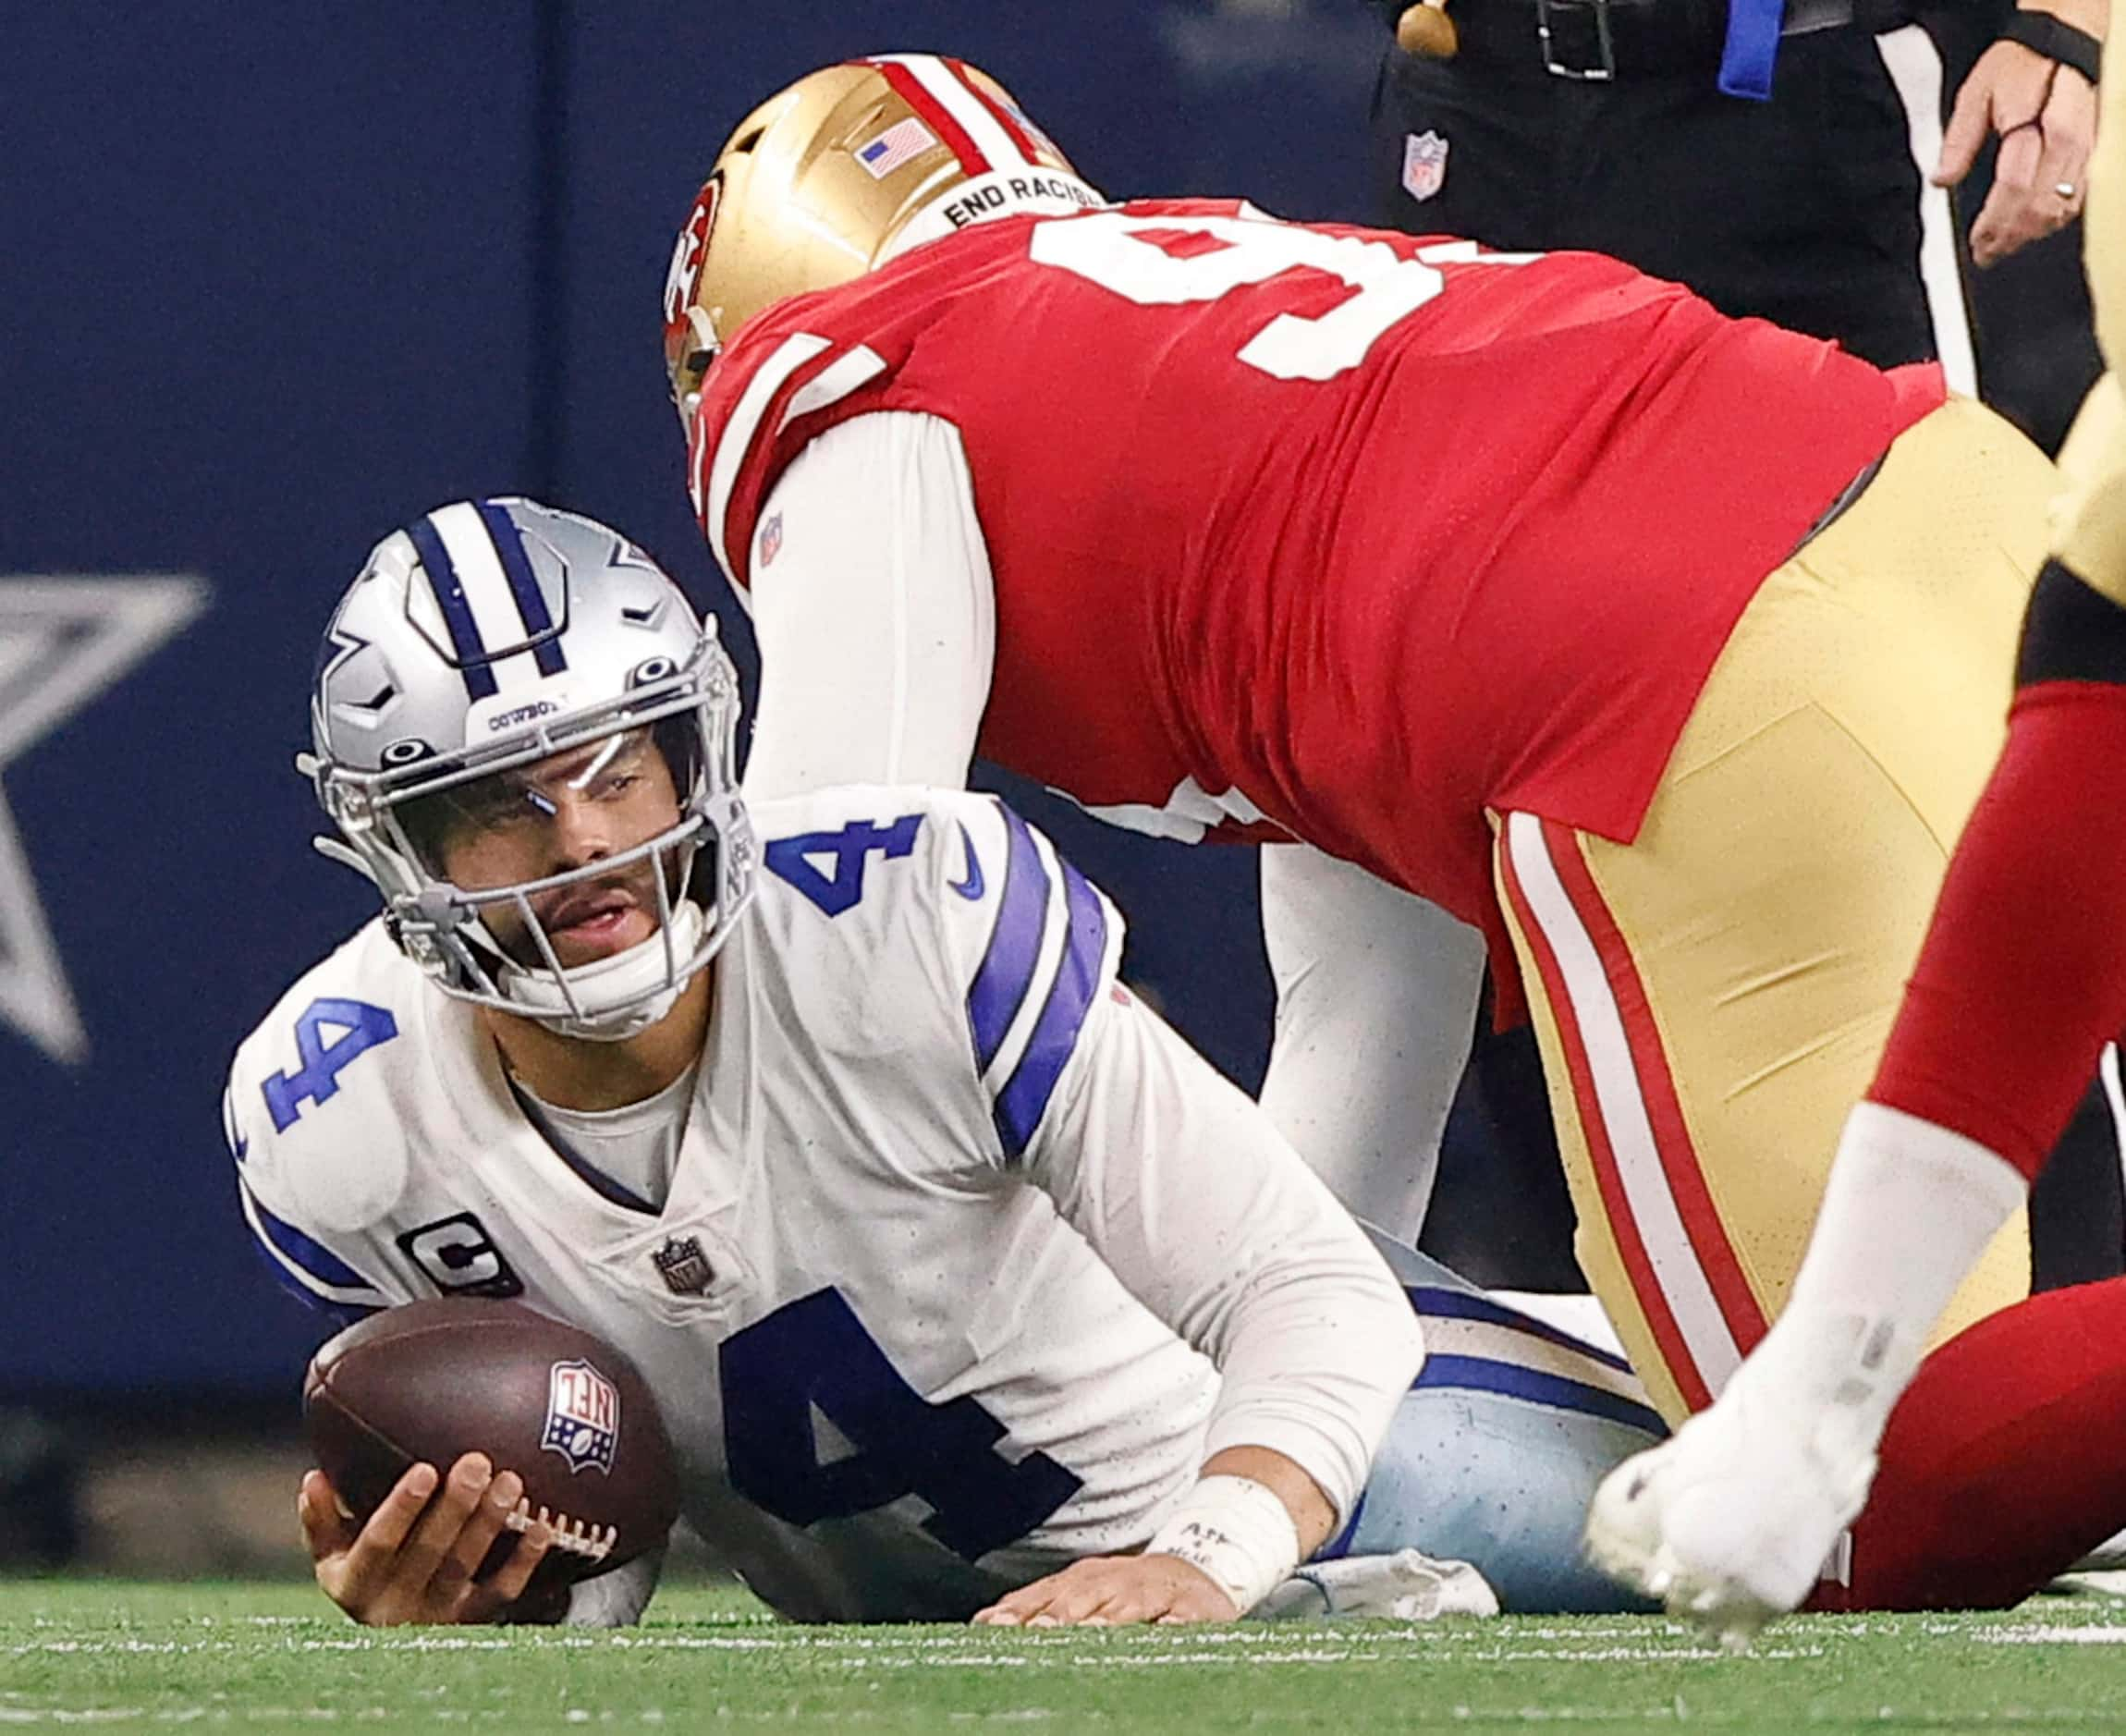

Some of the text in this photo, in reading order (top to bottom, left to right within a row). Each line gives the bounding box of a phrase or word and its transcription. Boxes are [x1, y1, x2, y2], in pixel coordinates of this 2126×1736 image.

[943, 185, 1005, 229] END
[764, 813, 926, 918] 4
[261, 997, 398, 1134] 4
[411, 1221, 500, 1286] C
[557, 1373, 611, 1434] NFL
[719, 1286, 1084, 1565] 4
